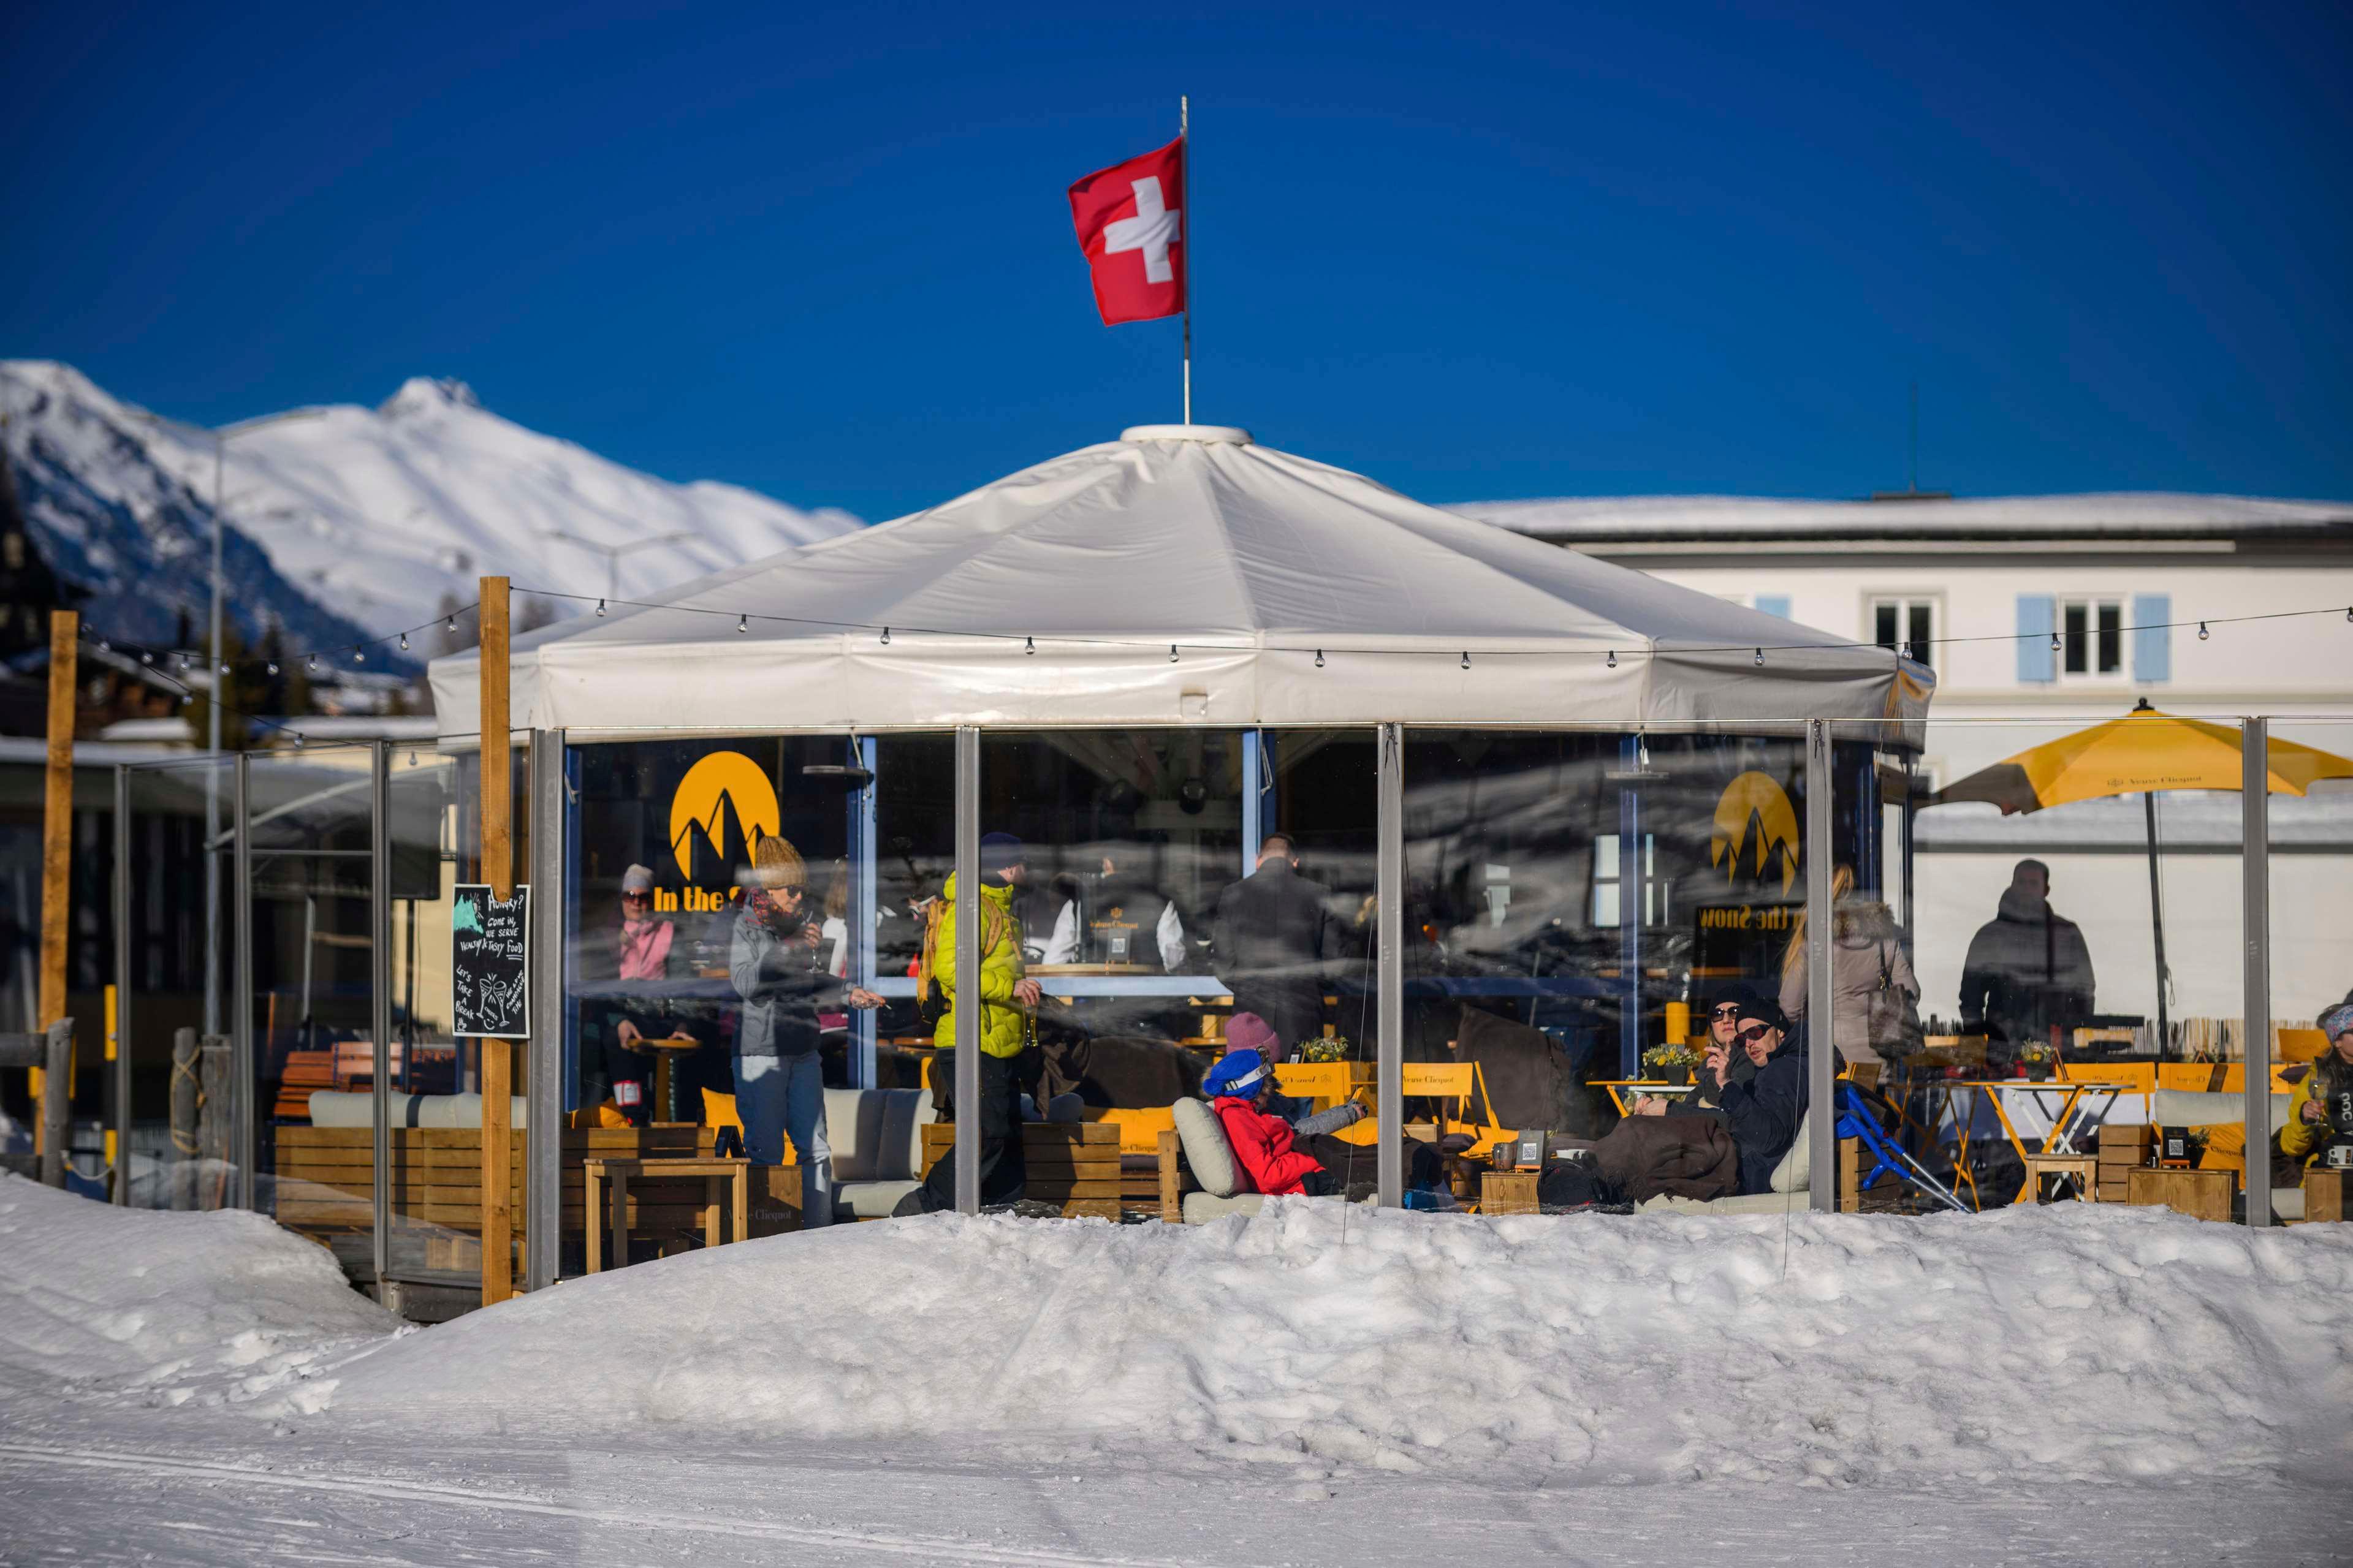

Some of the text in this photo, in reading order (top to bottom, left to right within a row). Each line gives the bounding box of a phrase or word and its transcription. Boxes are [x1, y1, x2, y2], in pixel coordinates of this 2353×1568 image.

[654, 886, 678, 912] In
[683, 886, 724, 912] the
[488, 917, 505, 927] COME
[485, 927, 519, 938] WE SERVE
[488, 941, 504, 958] TASTY
[457, 980, 473, 998] TAKE
[461, 997, 467, 1006] A
[455, 1000, 474, 1020] BREAK
[755, 1208, 793, 1223] Clicquot
